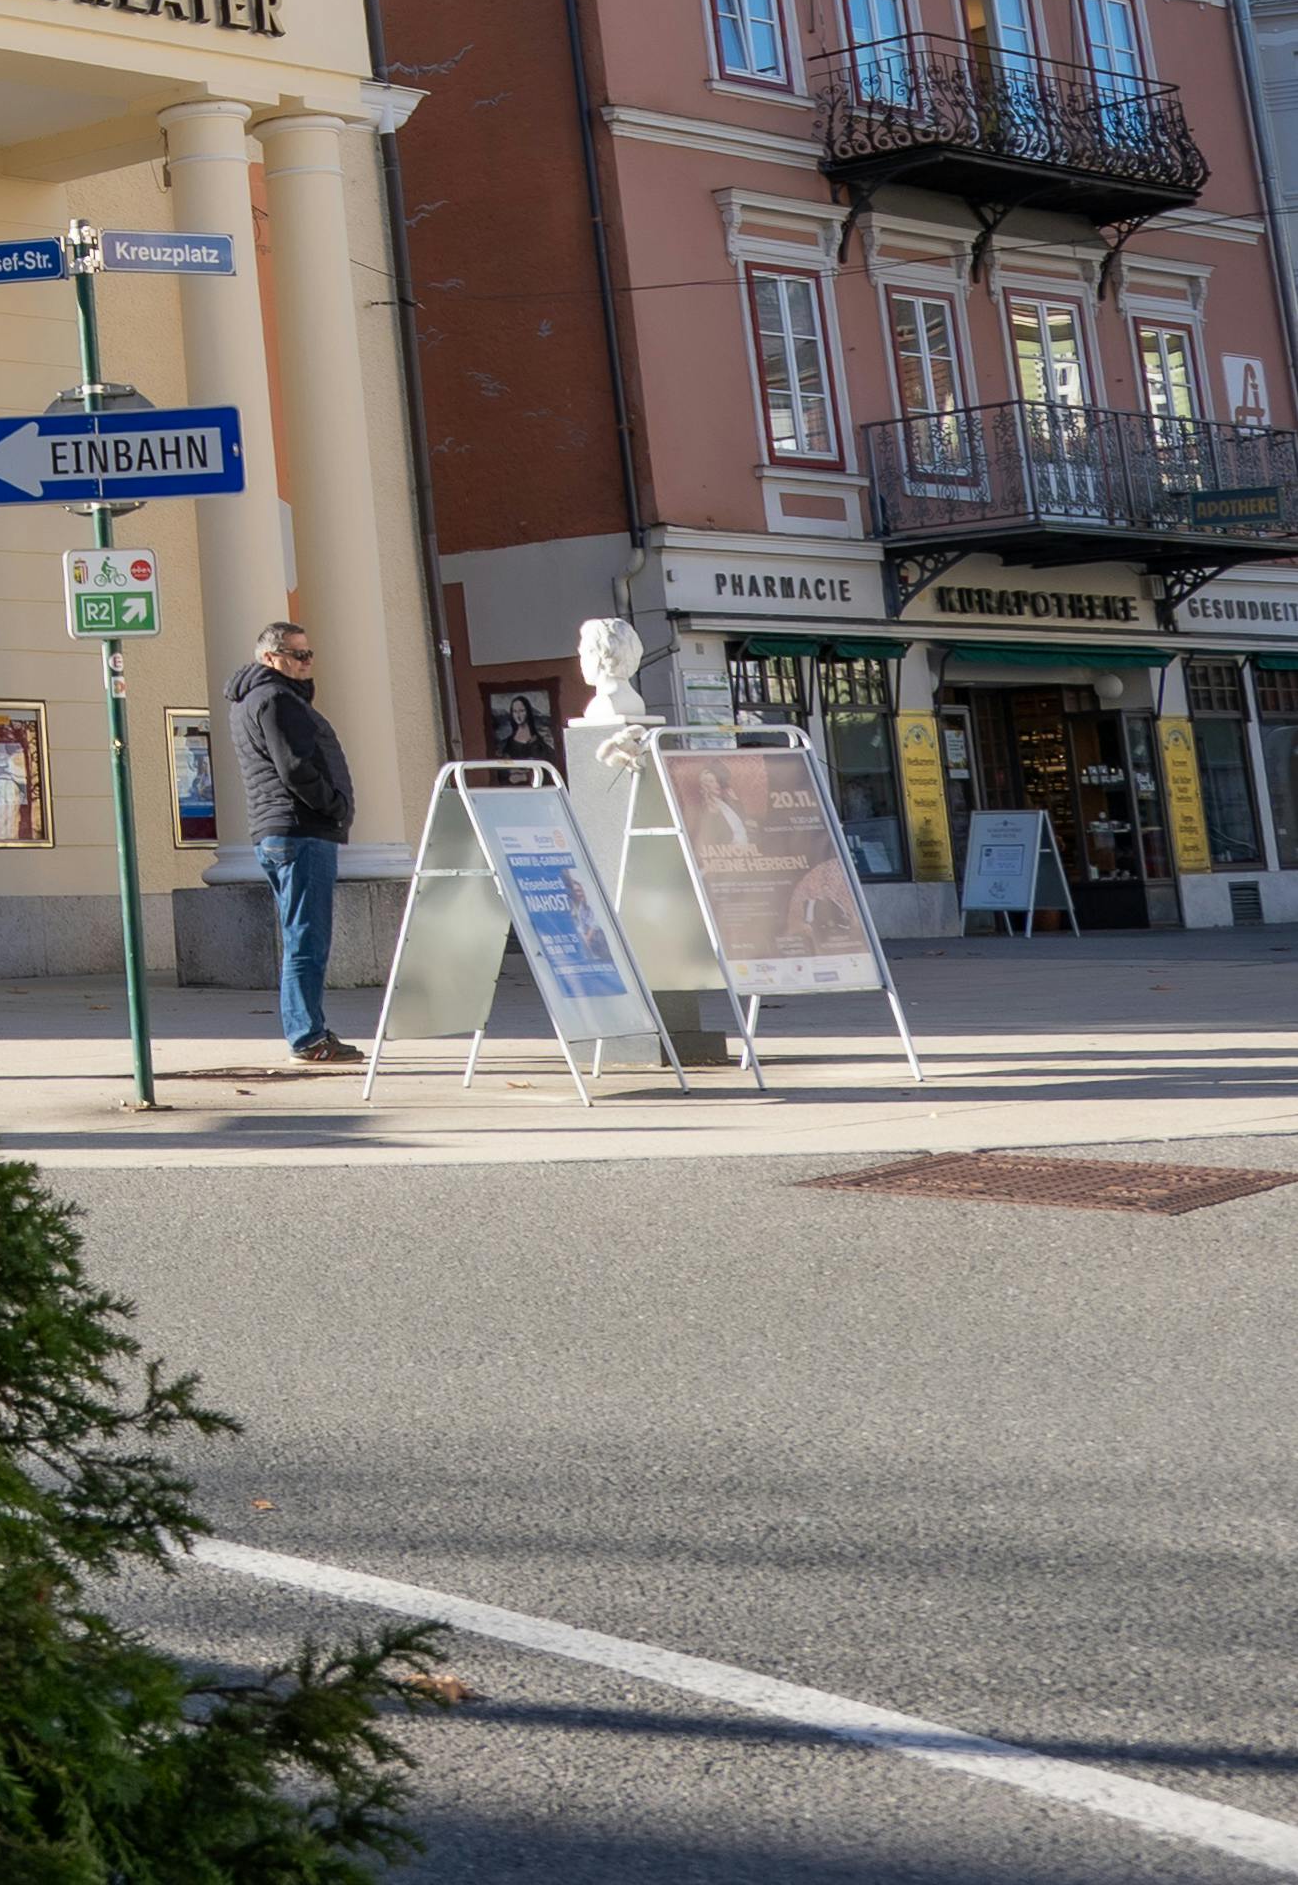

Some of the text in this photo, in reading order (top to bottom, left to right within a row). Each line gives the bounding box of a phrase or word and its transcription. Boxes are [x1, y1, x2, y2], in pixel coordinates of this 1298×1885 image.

[115, 240, 220, 271] Kreuzplatz
[50, 433, 209, 476] EINBAHN
[1196, 496, 1278, 518] APOTHEKE
[714, 572, 852, 602] PHARMACIE
[86, 602, 111, 622] R2
[935, 585, 1141, 622] KURAPOTHEKE
[771, 790, 817, 809] 20.11.
[746, 855, 810, 872] HERREN!
[525, 893, 571, 913] NAHOST
